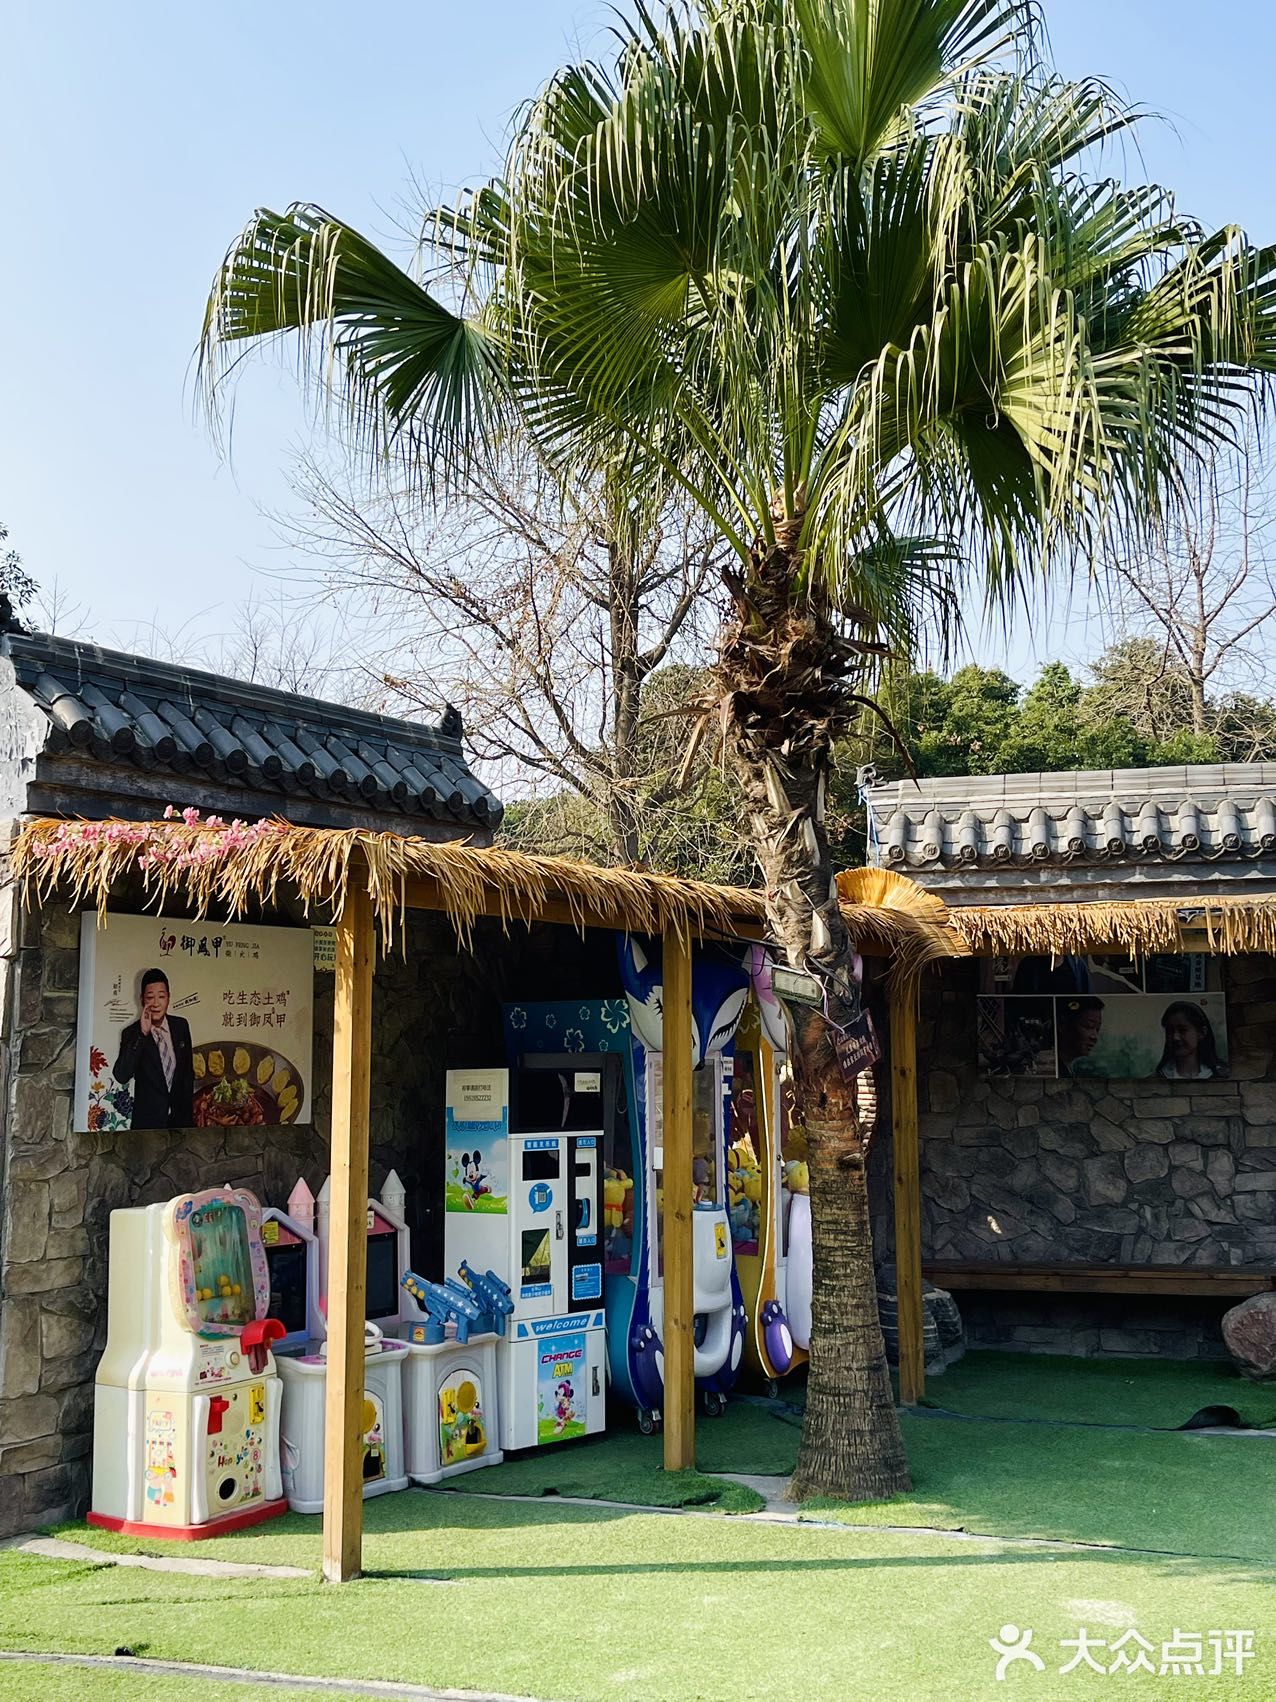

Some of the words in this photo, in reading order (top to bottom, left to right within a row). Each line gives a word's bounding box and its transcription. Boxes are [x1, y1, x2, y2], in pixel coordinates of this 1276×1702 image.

[222, 989, 287, 1007] 吃生态土鸡
[221, 1011, 287, 1029] 就到御凤甲
[535, 1318, 588, 1333] welcome
[541, 1349, 582, 1364] CHANGE
[552, 1361, 574, 1378] ATM
